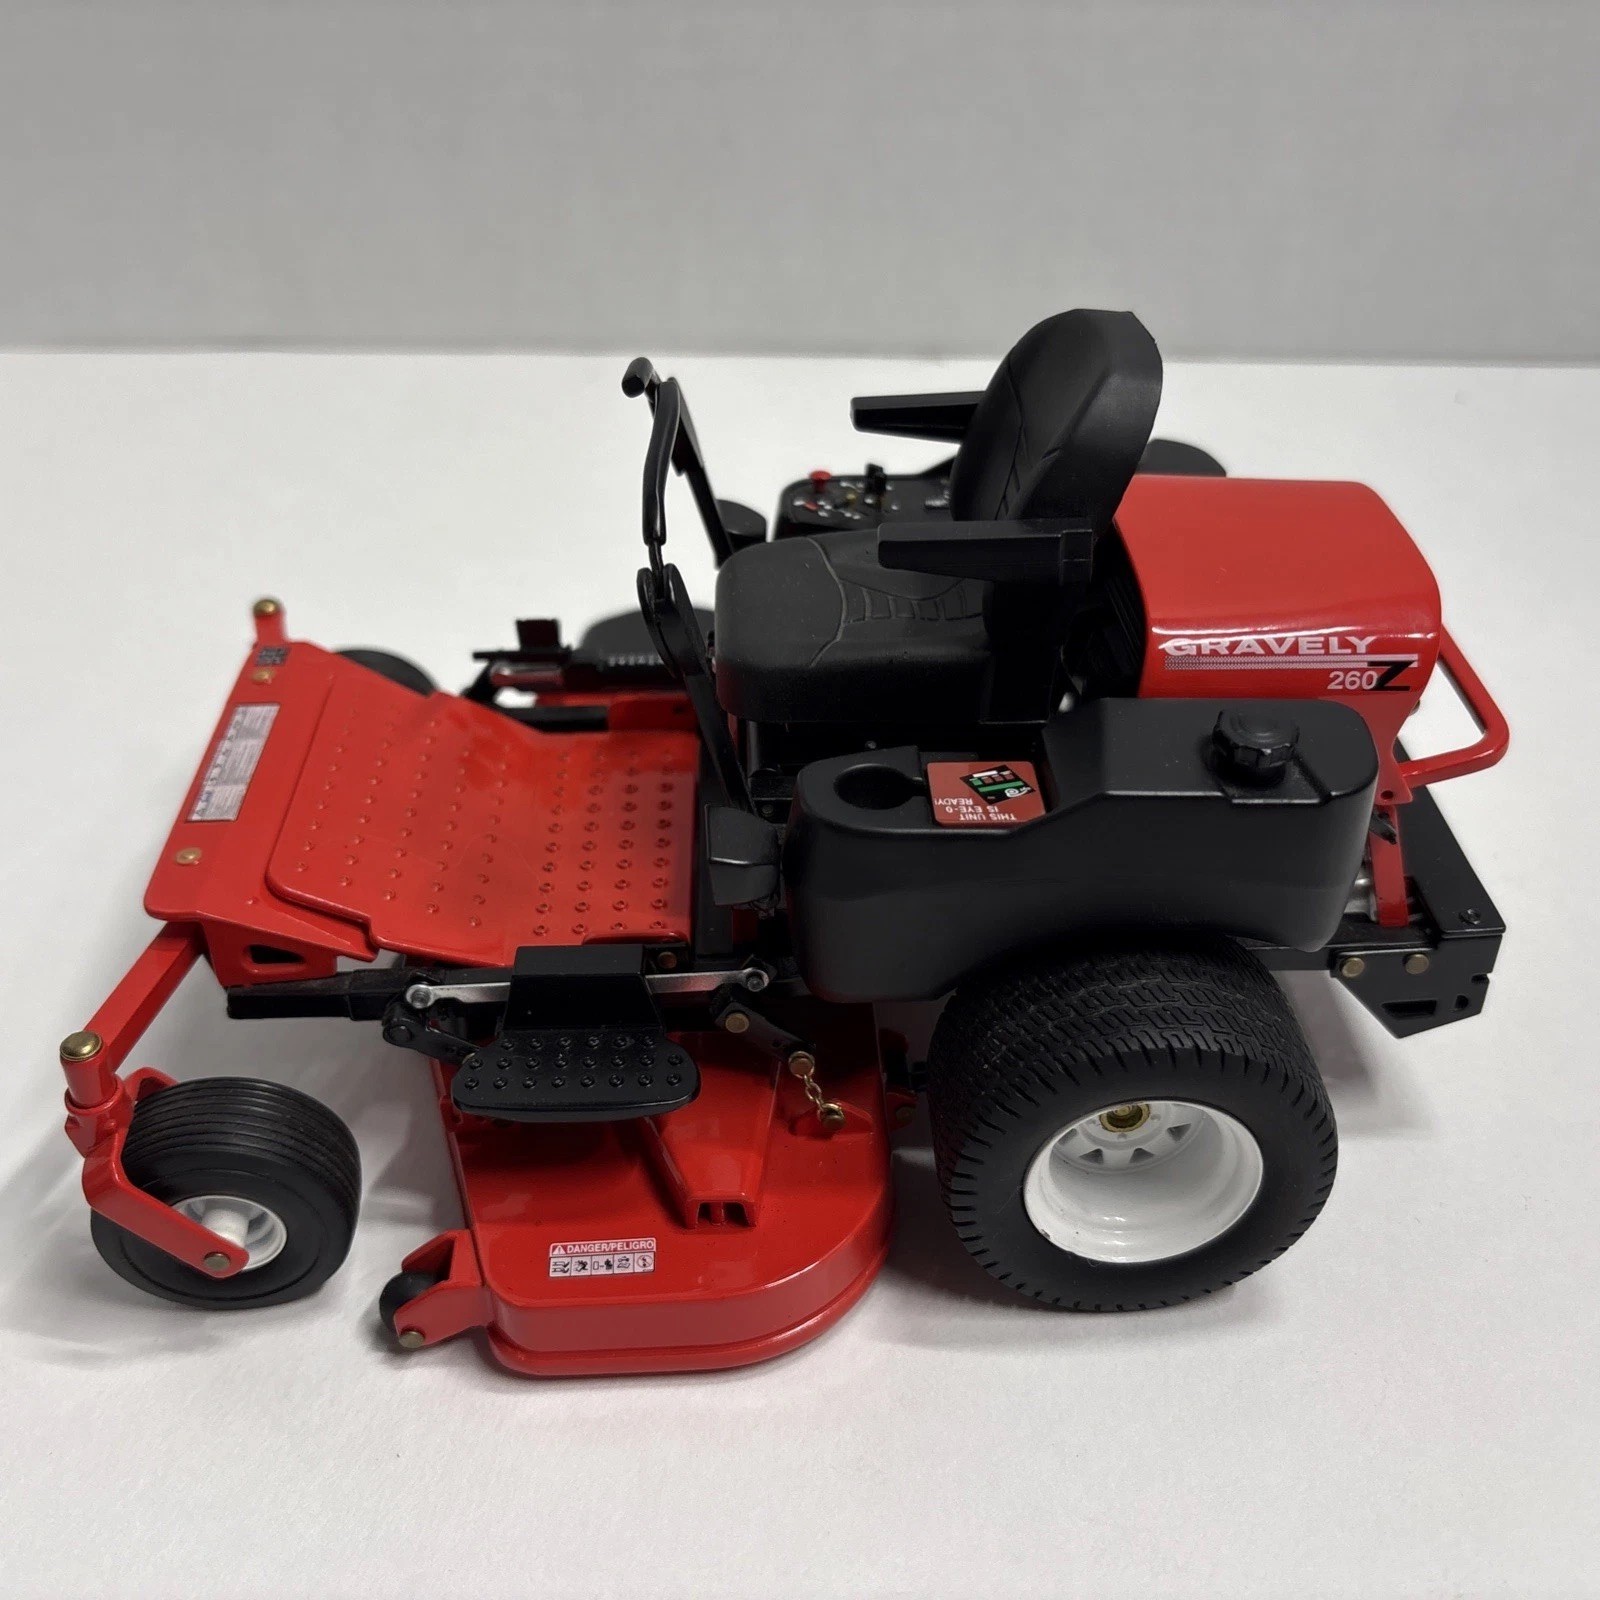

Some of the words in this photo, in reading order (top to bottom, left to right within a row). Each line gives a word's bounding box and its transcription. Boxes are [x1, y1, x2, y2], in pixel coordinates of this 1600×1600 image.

[1163, 636, 1377, 656] GRAVELY
[934, 797, 974, 806] READY!
[986, 805, 999, 813] IS
[959, 813, 986, 821] UNIT
[988, 813, 1018, 821] THIS
[566, 1240, 655, 1254] DANGER/PELIGRO
